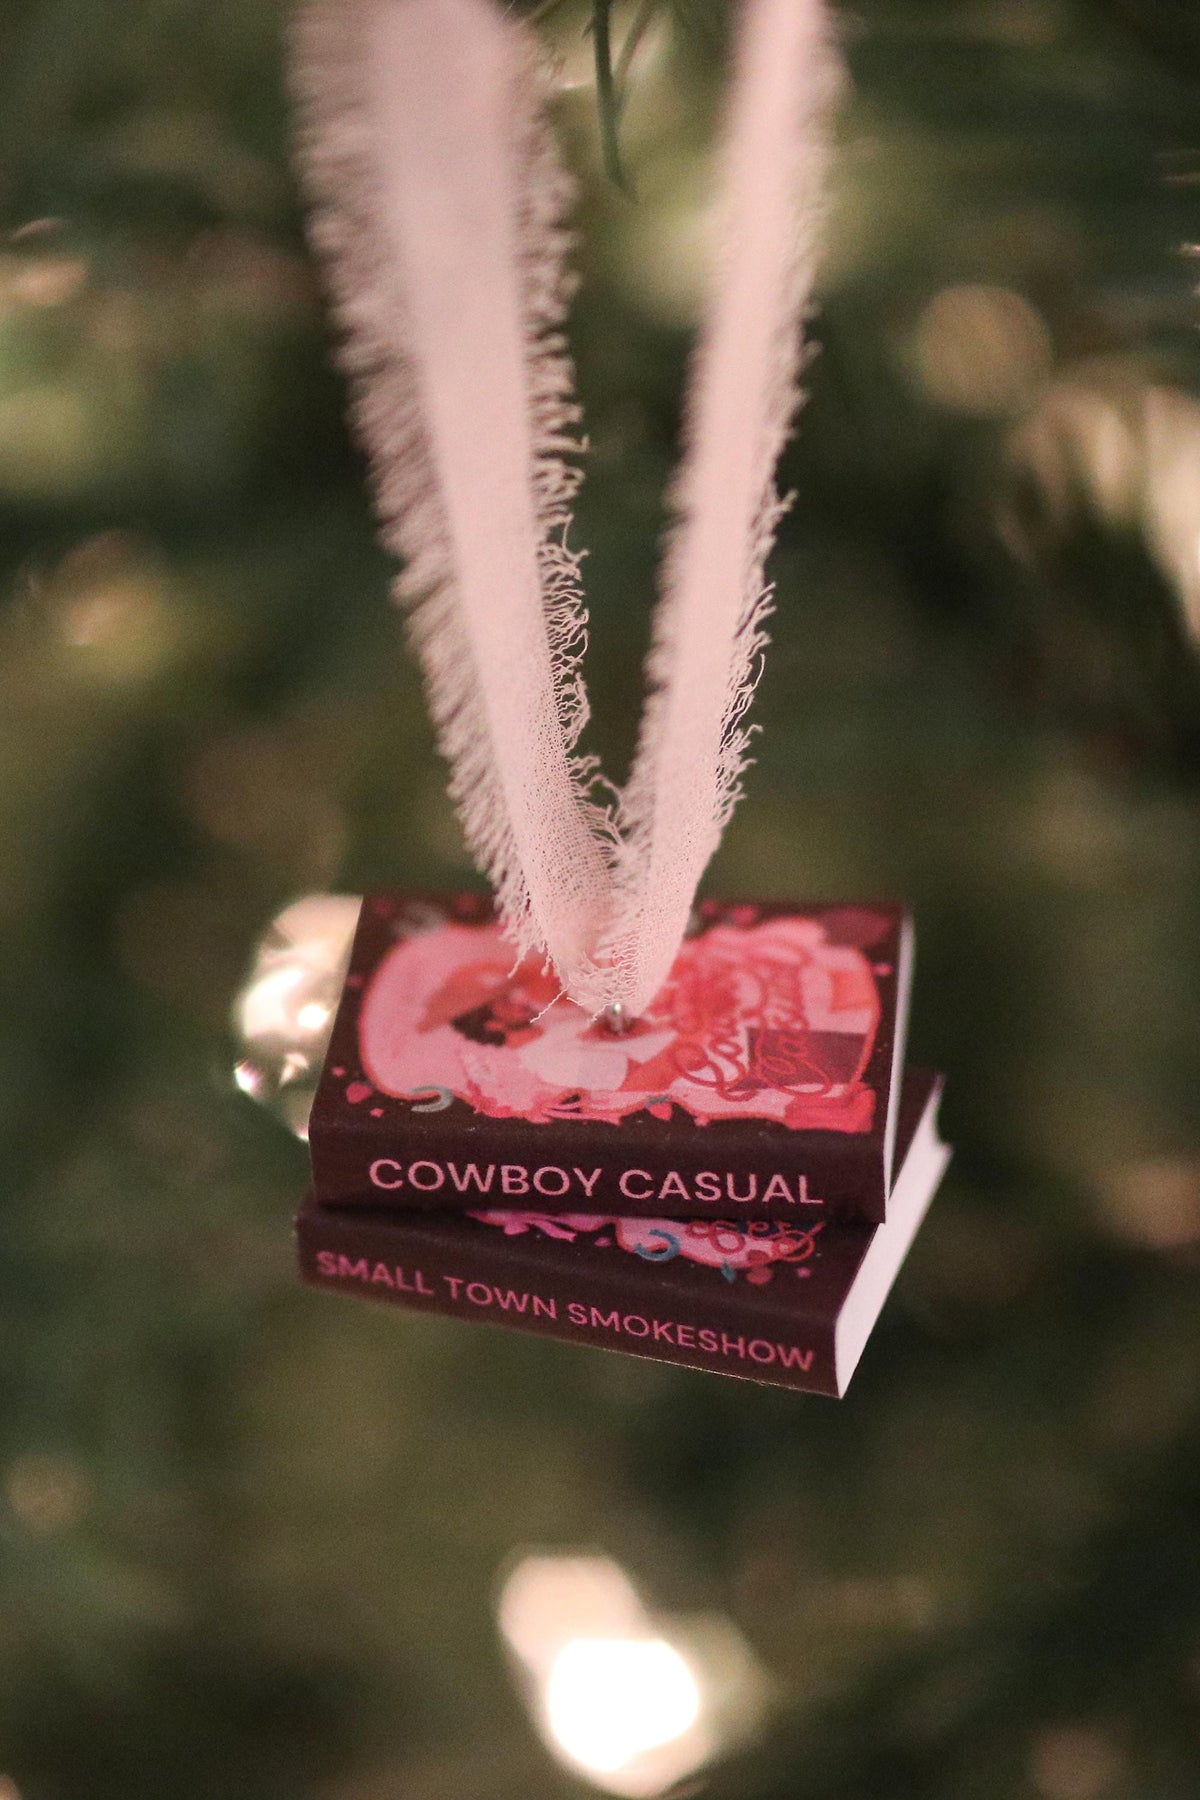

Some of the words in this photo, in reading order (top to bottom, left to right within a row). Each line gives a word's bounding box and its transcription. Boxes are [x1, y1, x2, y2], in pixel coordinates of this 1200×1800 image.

[369, 1159, 602, 1197] COWBOY
[618, 1169, 824, 1205] CASUAL
[316, 1251, 434, 1296] SMALL
[443, 1275, 557, 1320] TOWN
[567, 1303, 814, 1372] SMOKESHOW
